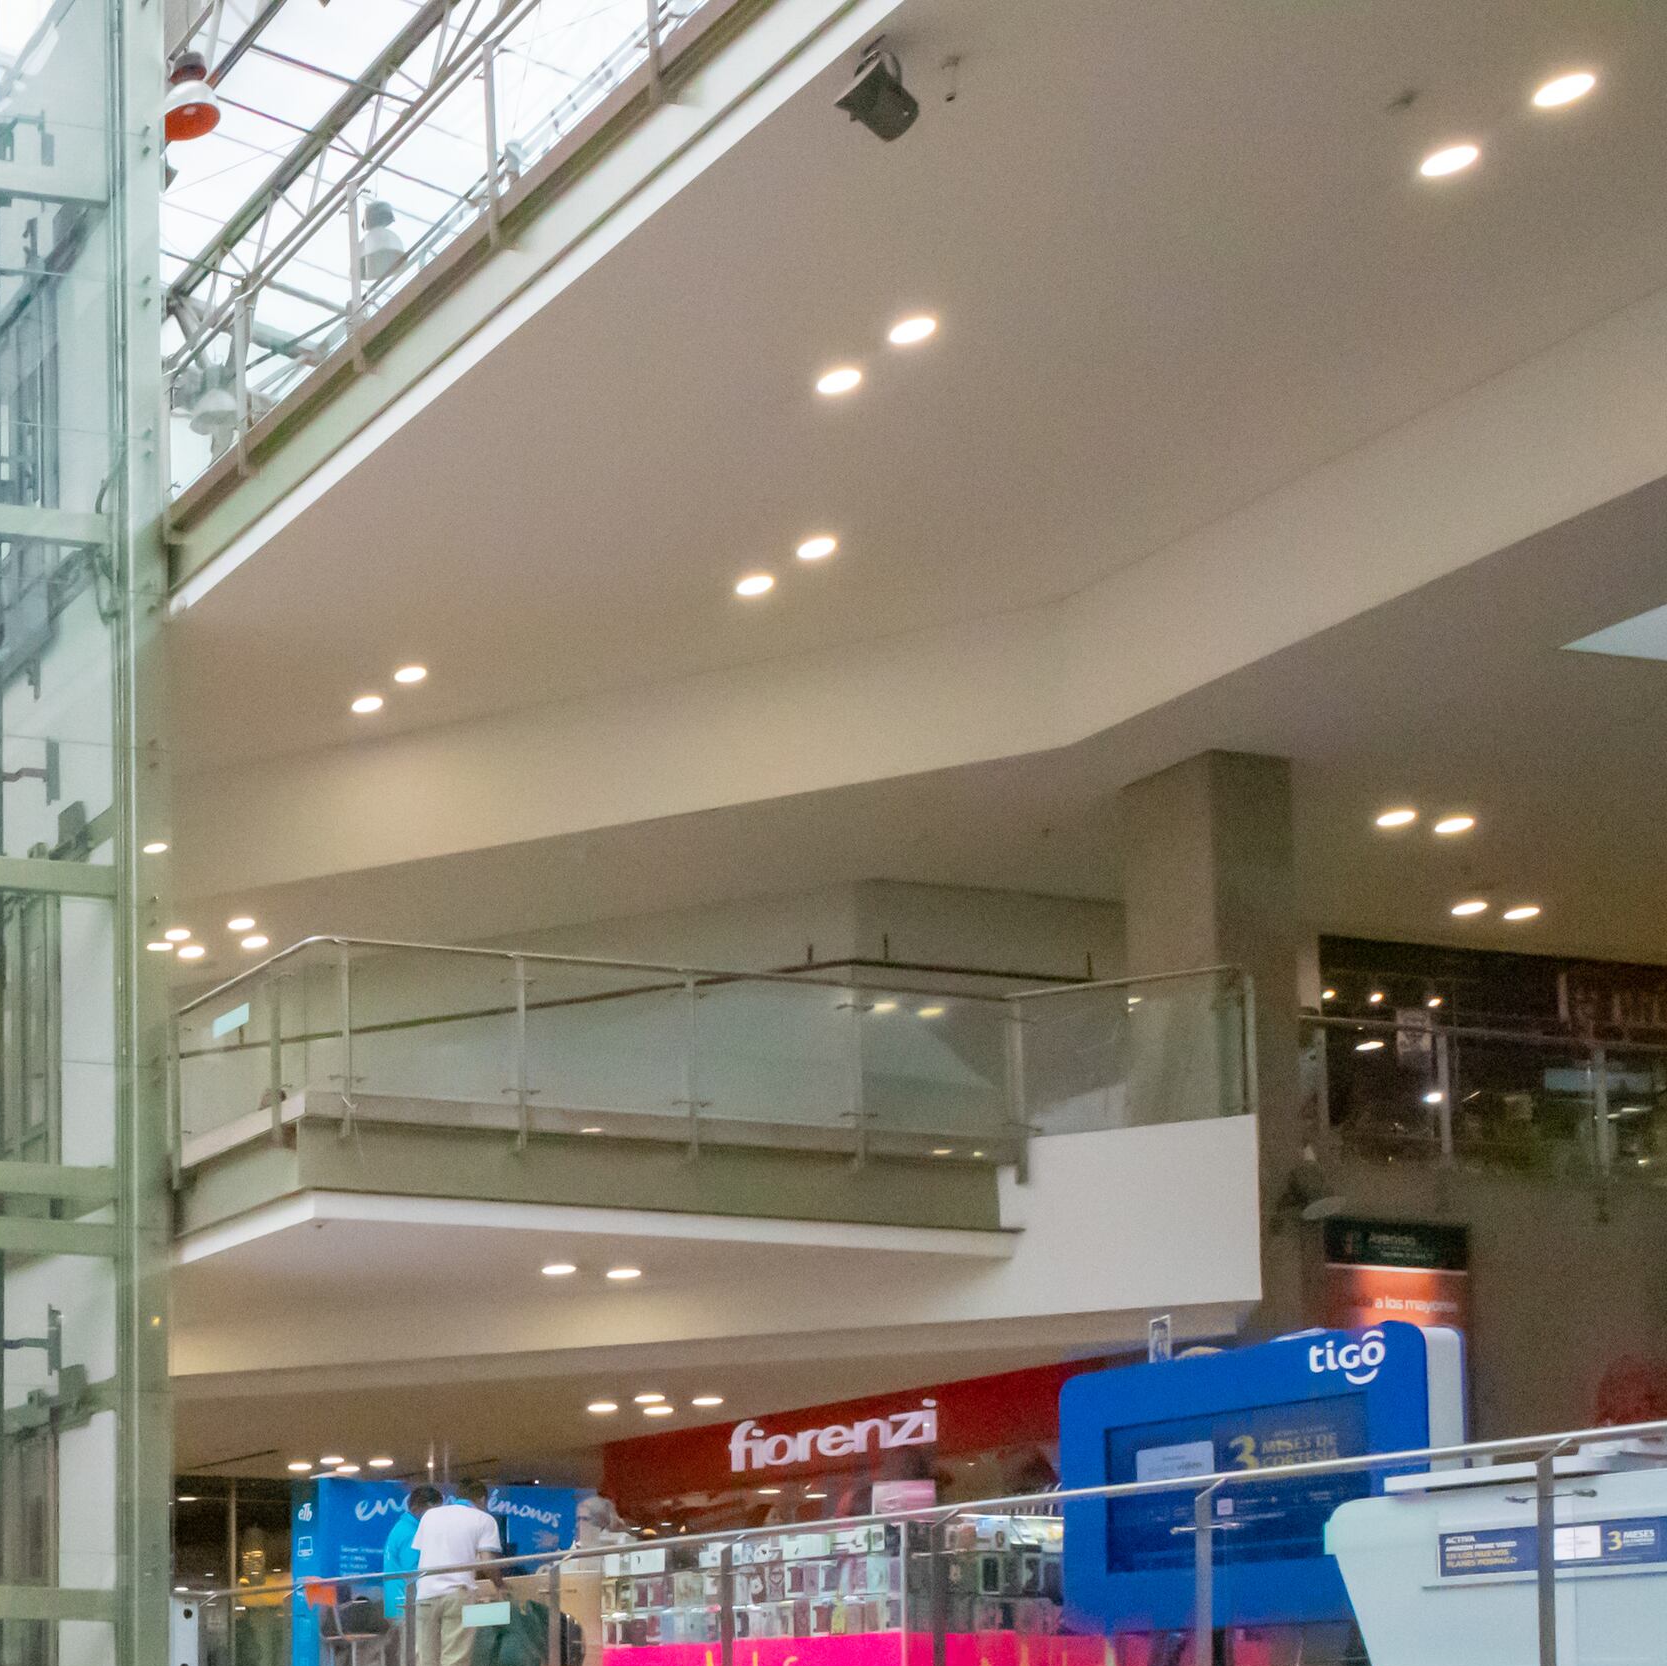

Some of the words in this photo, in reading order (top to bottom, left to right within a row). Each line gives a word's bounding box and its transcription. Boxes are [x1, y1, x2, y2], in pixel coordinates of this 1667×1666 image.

[728, 1398, 937, 1473] fiorenzi
[1229, 1434, 1260, 1470] 3
[1607, 1529, 1623, 1552] 3
[1623, 1528, 1655, 1540] MESES
